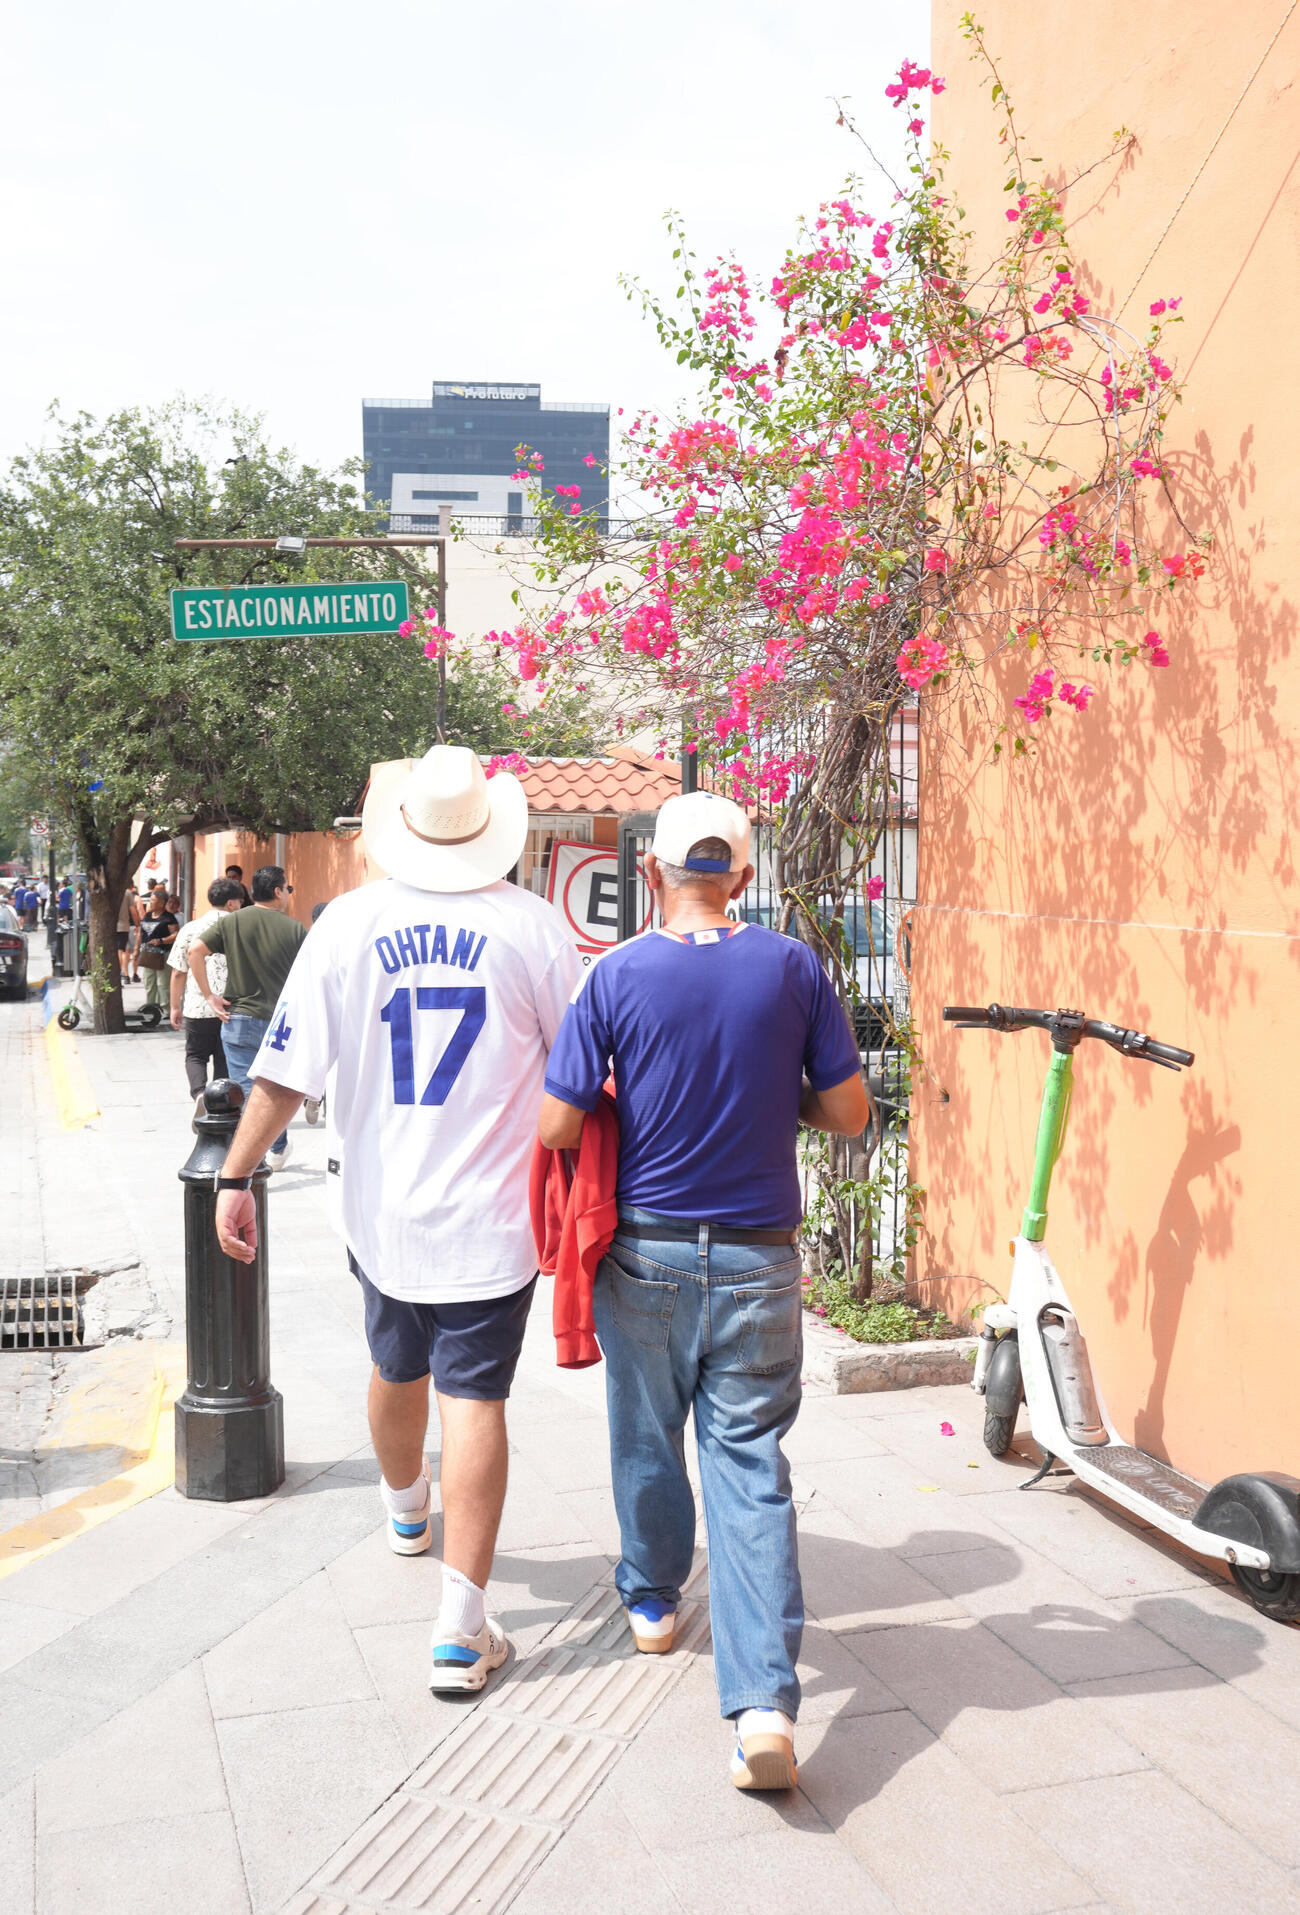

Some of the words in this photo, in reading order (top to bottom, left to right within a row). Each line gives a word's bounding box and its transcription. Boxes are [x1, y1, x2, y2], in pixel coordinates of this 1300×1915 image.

[464, 387, 527, 400] Profuturo
[184, 593, 397, 629] ESTACIONAMIENTO
[375, 924, 488, 975] OHTANI
[381, 986, 487, 1106] 17
